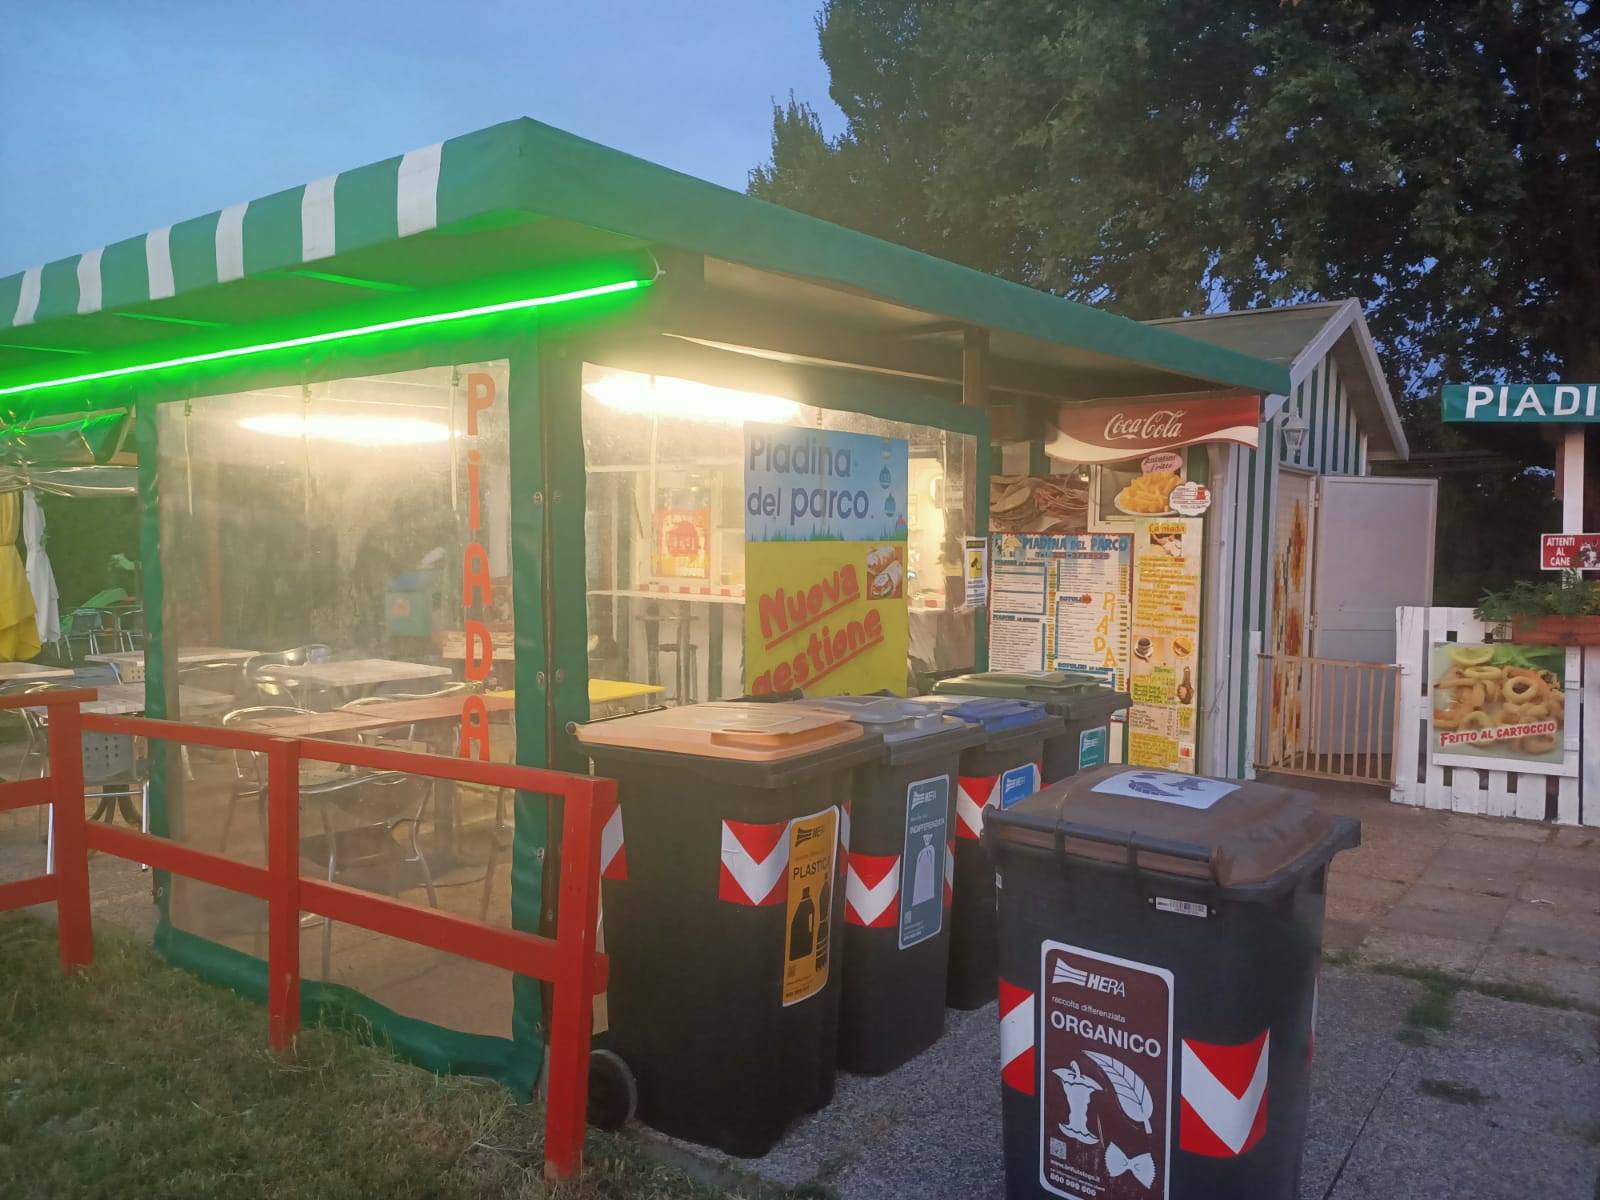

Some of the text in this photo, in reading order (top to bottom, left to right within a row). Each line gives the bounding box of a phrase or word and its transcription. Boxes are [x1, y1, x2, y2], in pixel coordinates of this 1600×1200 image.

[1465, 385, 1597, 419] PIADI
[750, 437, 851, 477] Piadina
[748, 486, 869, 525] del parco
[1090, 535, 1129, 551] PARCO
[1546, 537, 1576, 547] ATTENTI
[1556, 547, 1566, 557] AL
[1550, 557, 1571, 567] CANE
[759, 564, 860, 639] Nuova
[1440, 722, 1555, 747] FRITTO AL CARTOCCIO
[1087, 973, 1126, 998] HERA
[1052, 995, 1126, 1023] raccolta differenziata
[1051, 1010, 1161, 1058] ORGANICO
